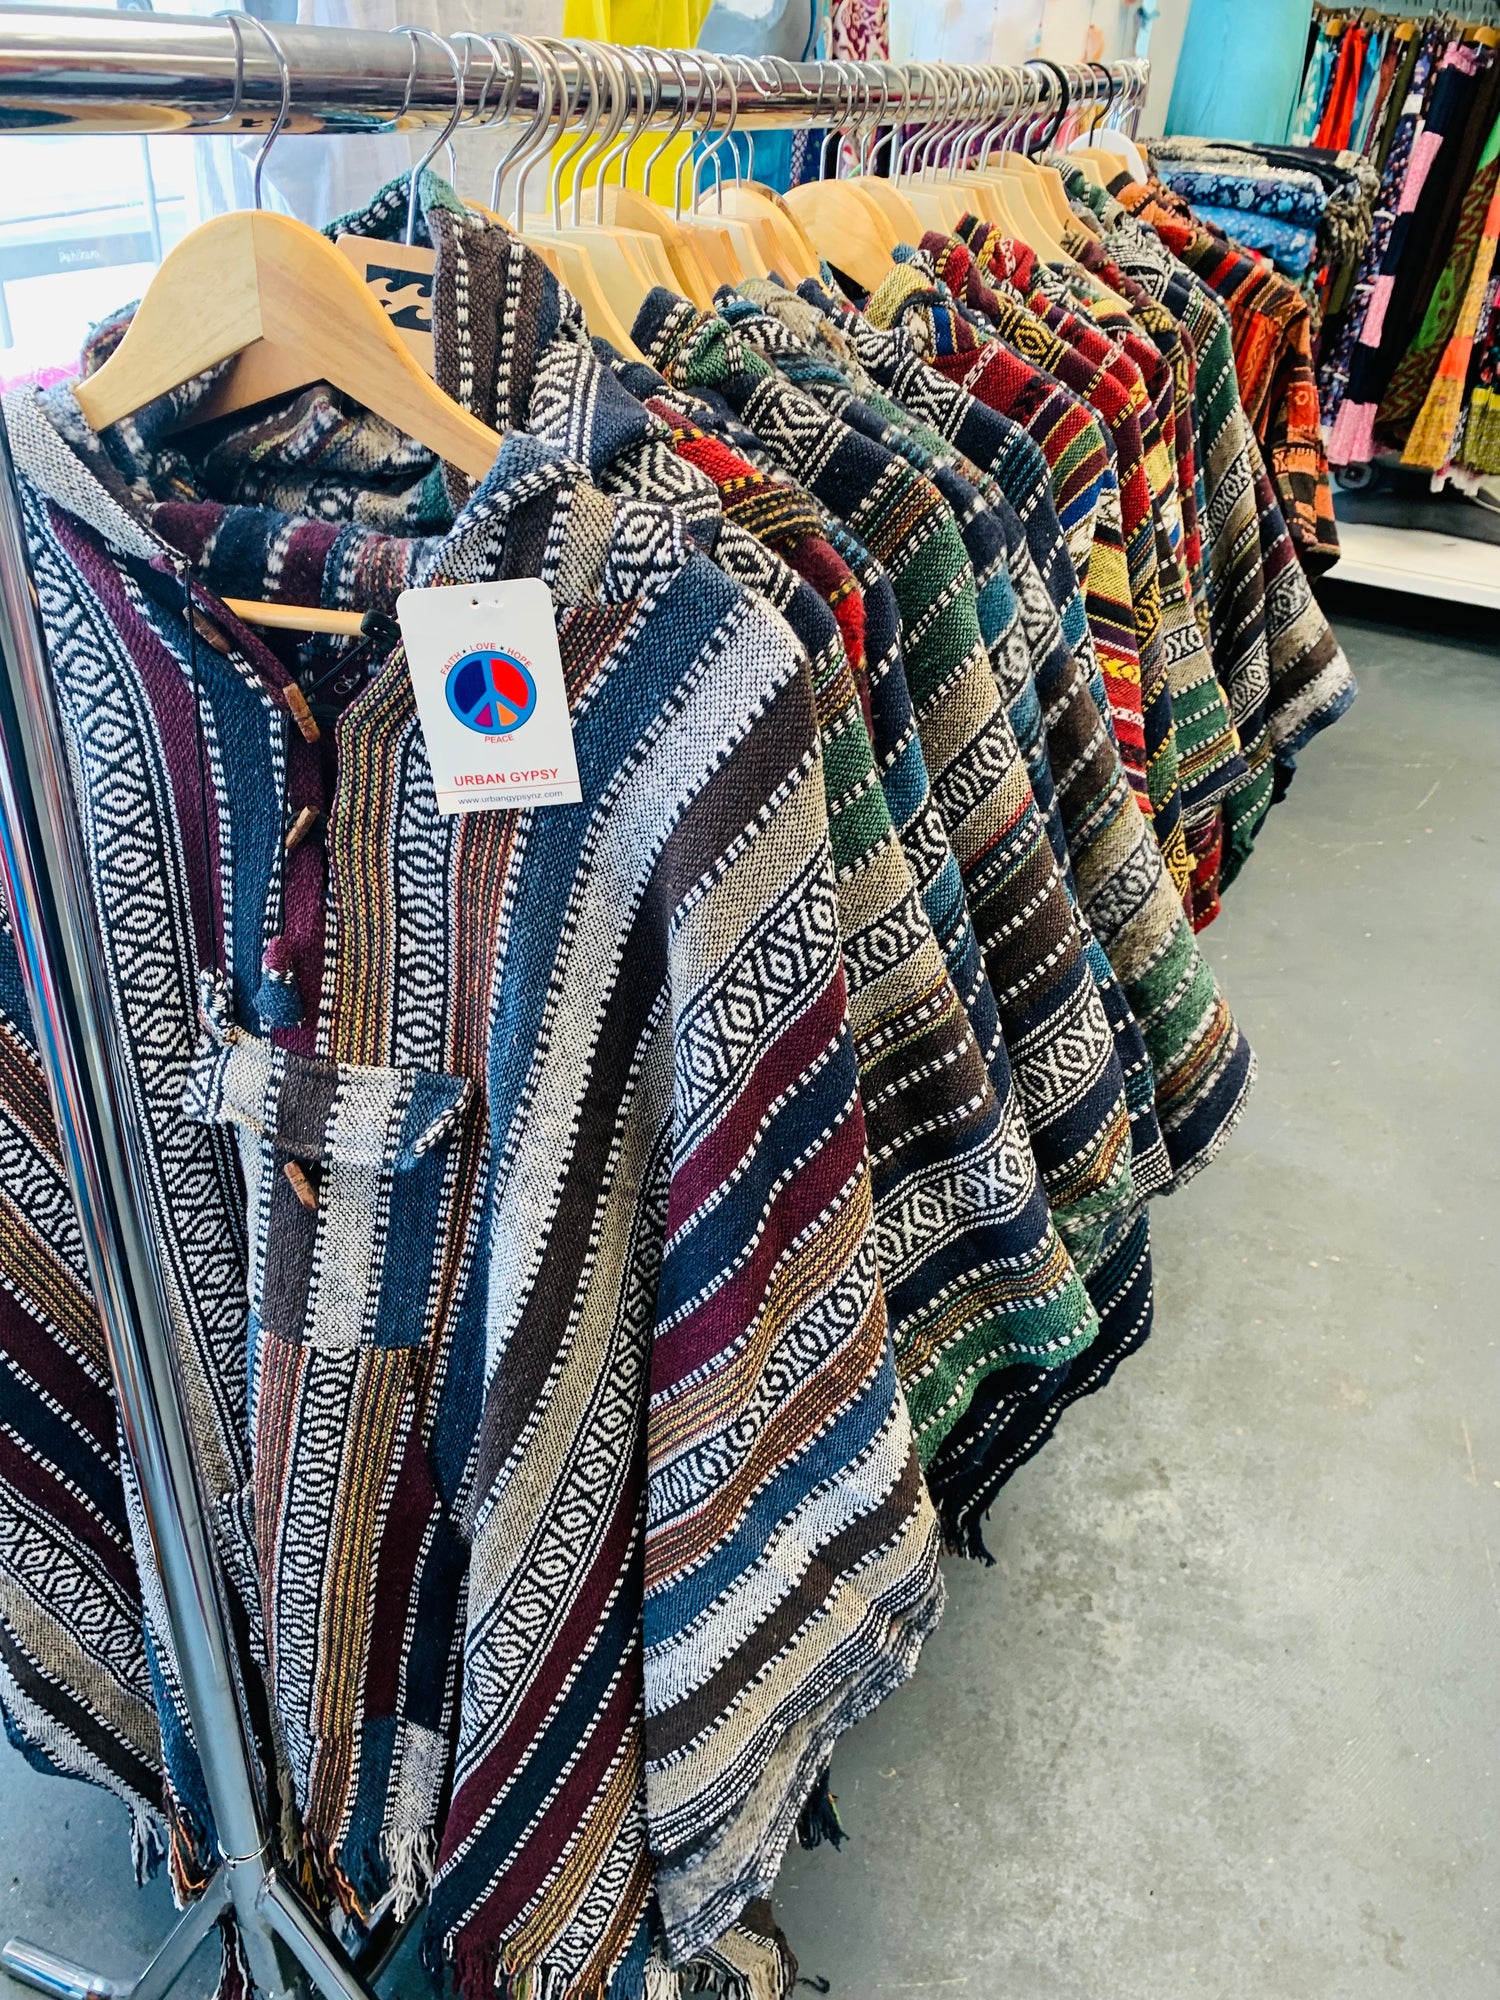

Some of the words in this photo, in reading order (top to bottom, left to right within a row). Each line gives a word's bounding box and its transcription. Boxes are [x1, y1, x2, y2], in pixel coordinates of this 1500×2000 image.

[440, 652, 462, 675] FAITH
[469, 642, 496, 652] LOVE
[506, 647, 532, 668] HOPE
[484, 734, 514, 743] PEACE
[454, 773, 506, 786] URBAN
[510, 768, 558, 783] GYPSY
[458, 790, 563, 805] www.urbangypsynz.com
